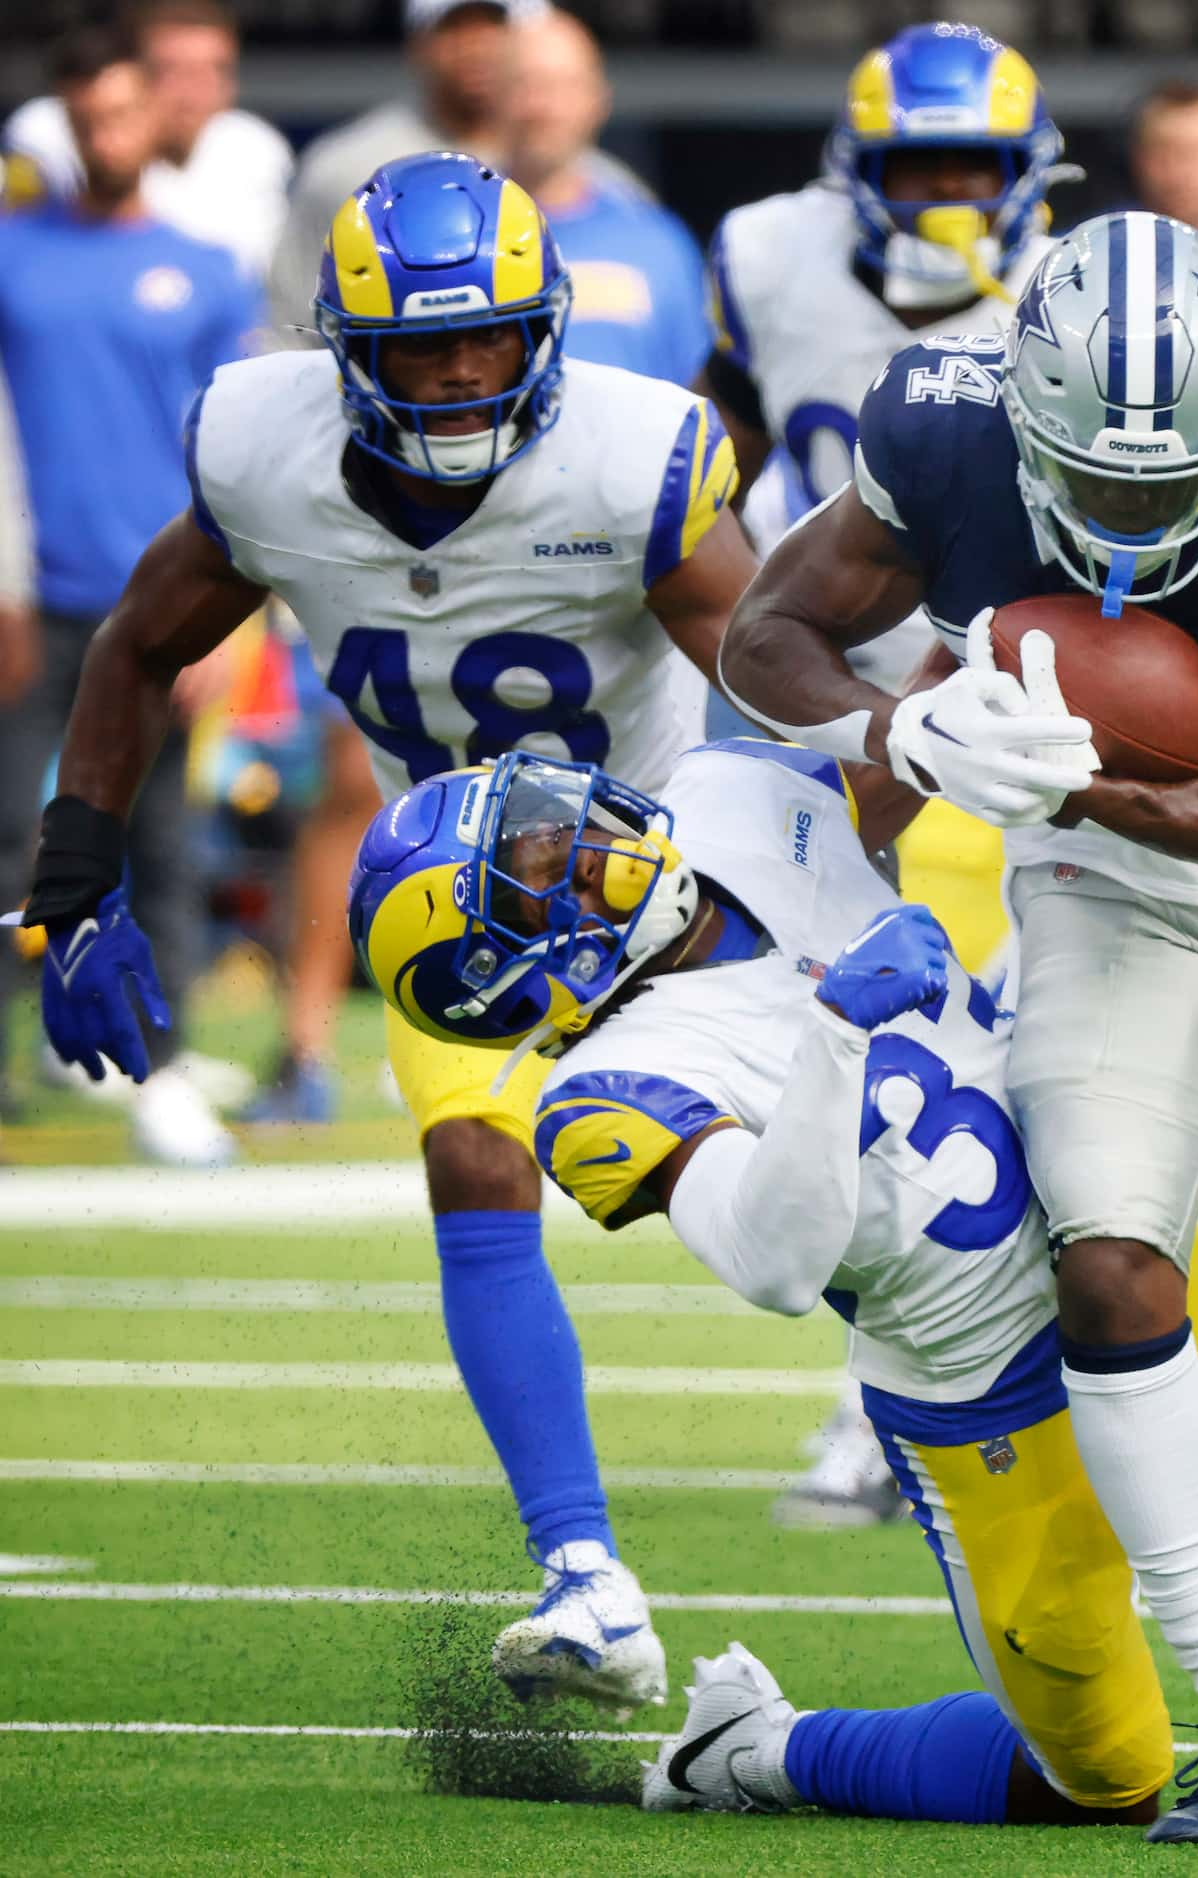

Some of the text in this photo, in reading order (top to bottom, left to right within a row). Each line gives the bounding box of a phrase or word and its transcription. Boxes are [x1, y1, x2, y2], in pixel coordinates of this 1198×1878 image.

[1108, 440, 1169, 453] COWBOYS
[534, 541, 614, 557] RAMS
[328, 626, 611, 786] 48
[794, 809, 813, 866] RAMS
